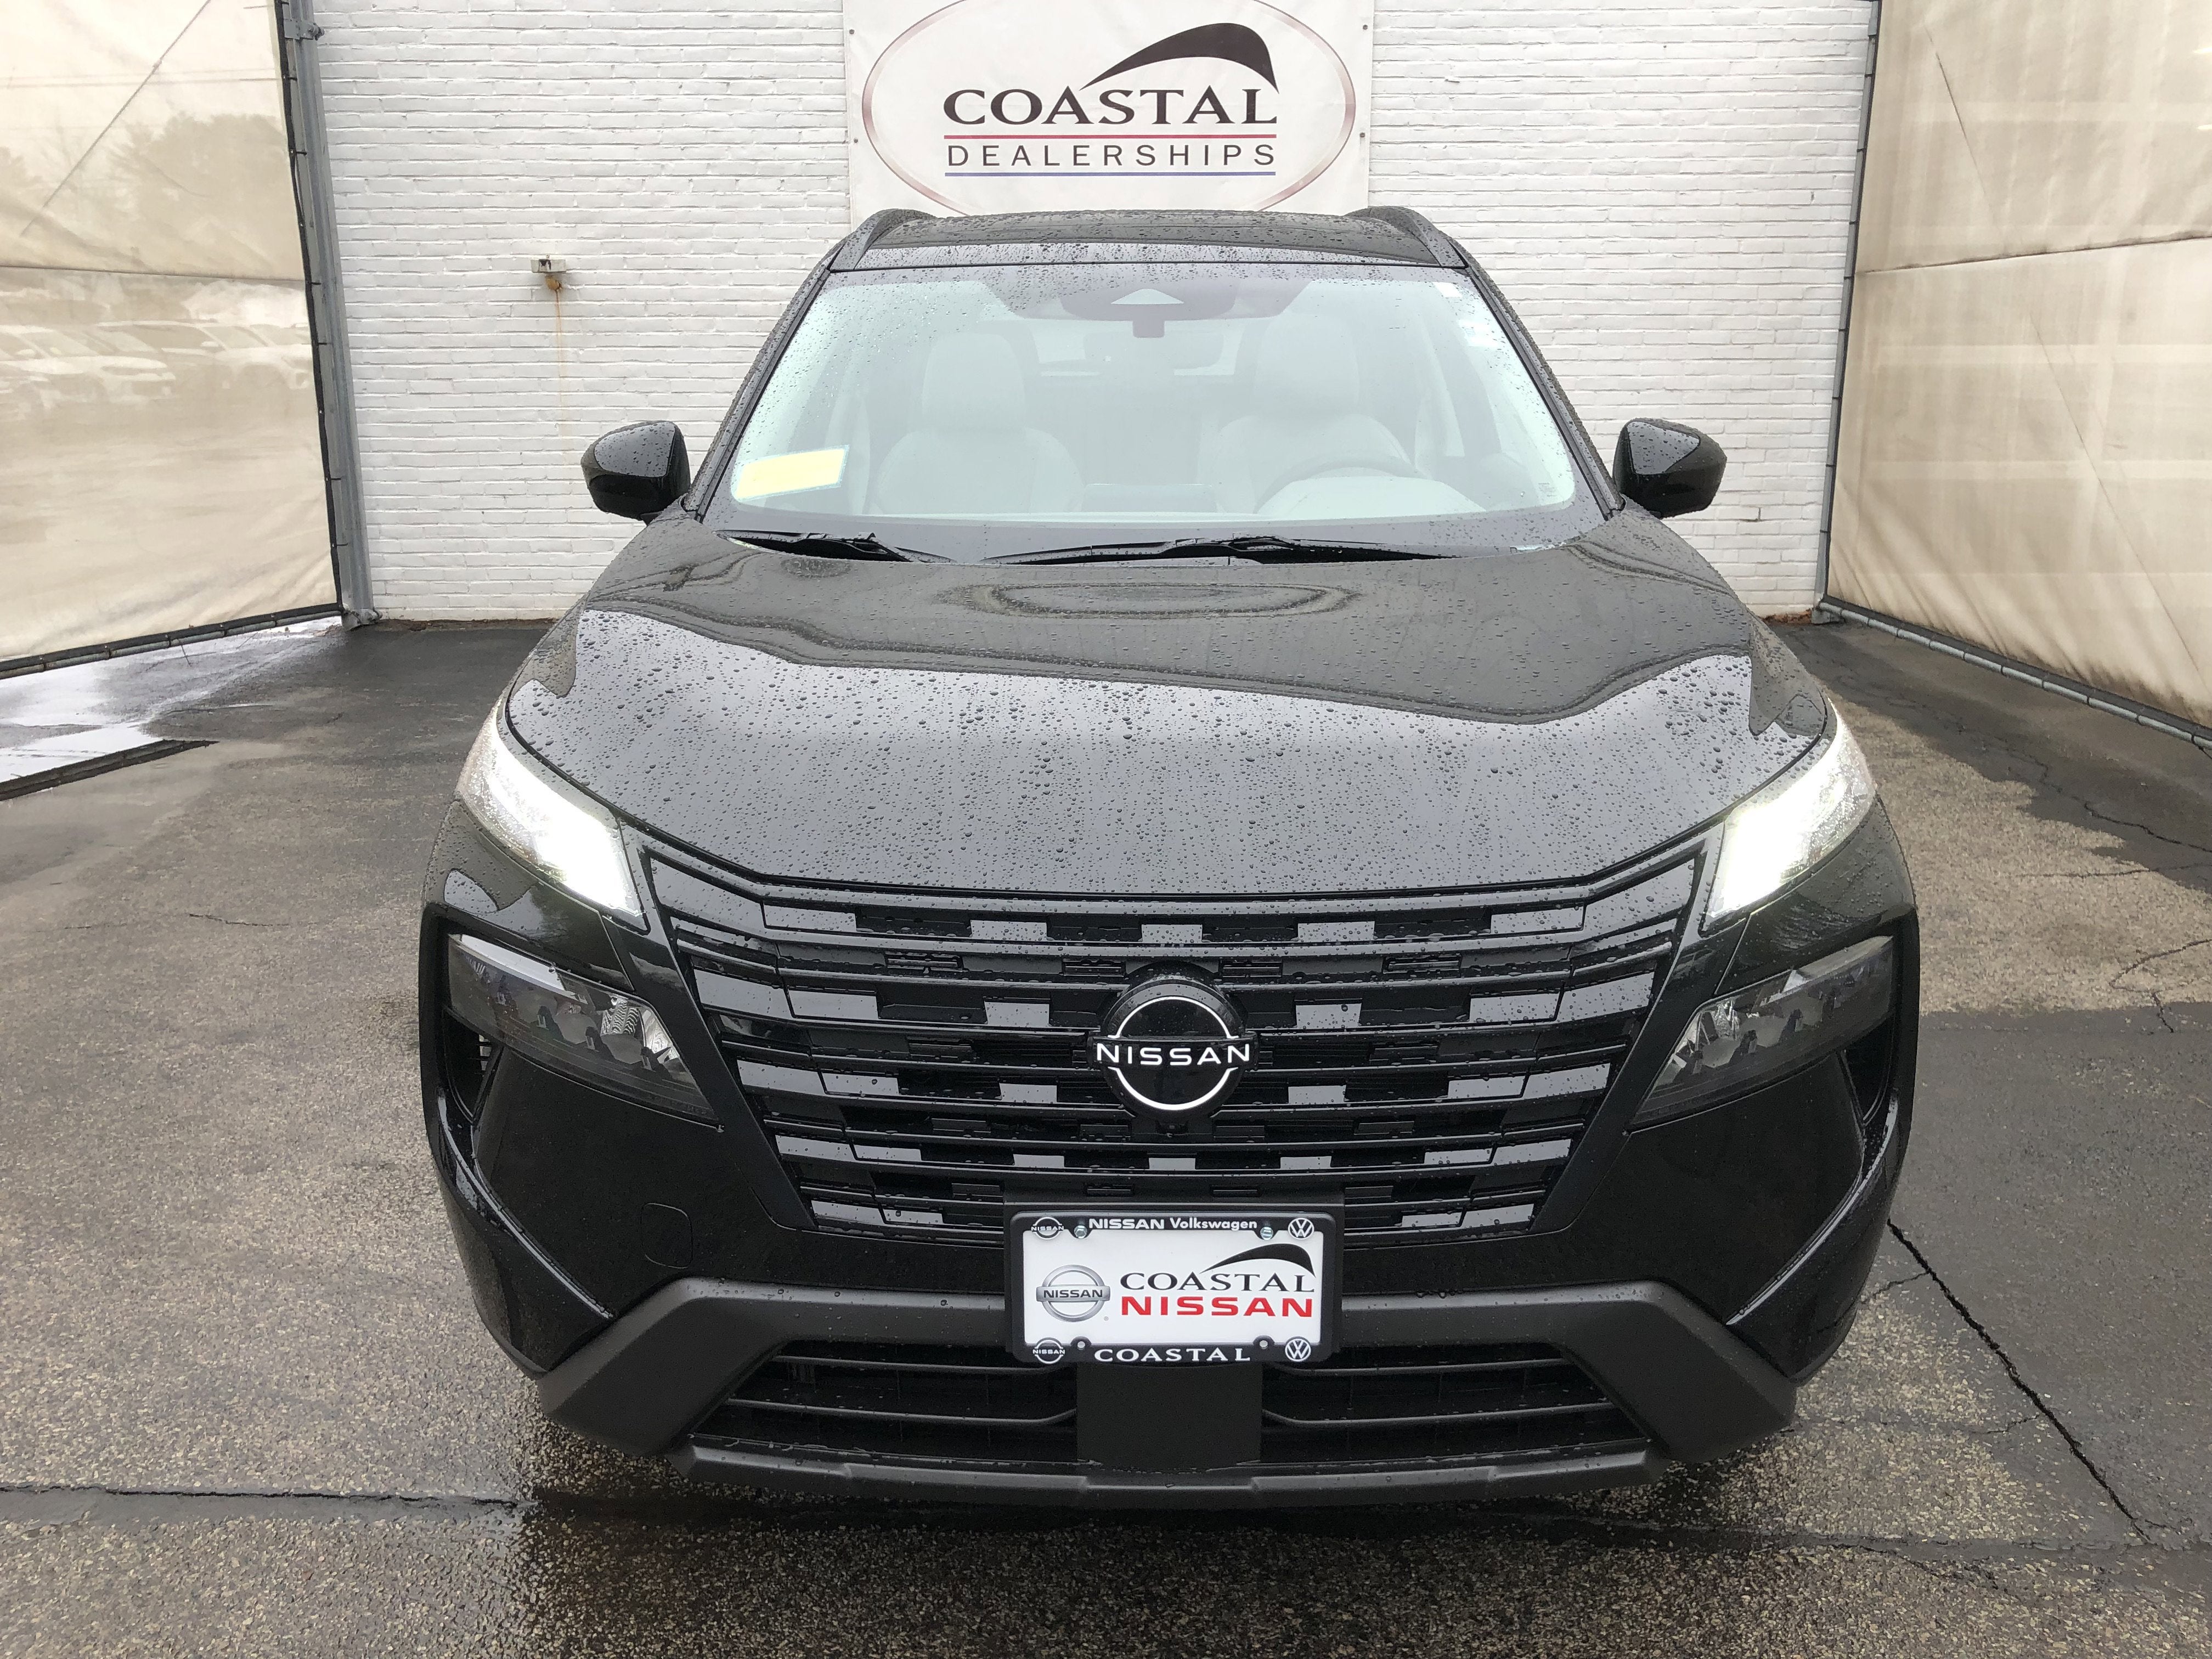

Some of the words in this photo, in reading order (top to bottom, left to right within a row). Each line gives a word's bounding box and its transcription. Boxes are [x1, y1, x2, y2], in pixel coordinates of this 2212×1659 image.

[943, 86, 1277, 125] COASTAL
[948, 144, 1275, 166] DEALERSHIPS
[1097, 1042, 1250, 1065] NISSAN
[1089, 1218, 1164, 1229] NISSAN
[1170, 1218, 1257, 1231] Volkswagen
[1120, 1271, 1314, 1293] COASTAL
[1043, 1289, 1103, 1299] NISSAN
[1121, 1296, 1312, 1317] NISSAN
[1094, 1348, 1251, 1362] COASTAL
